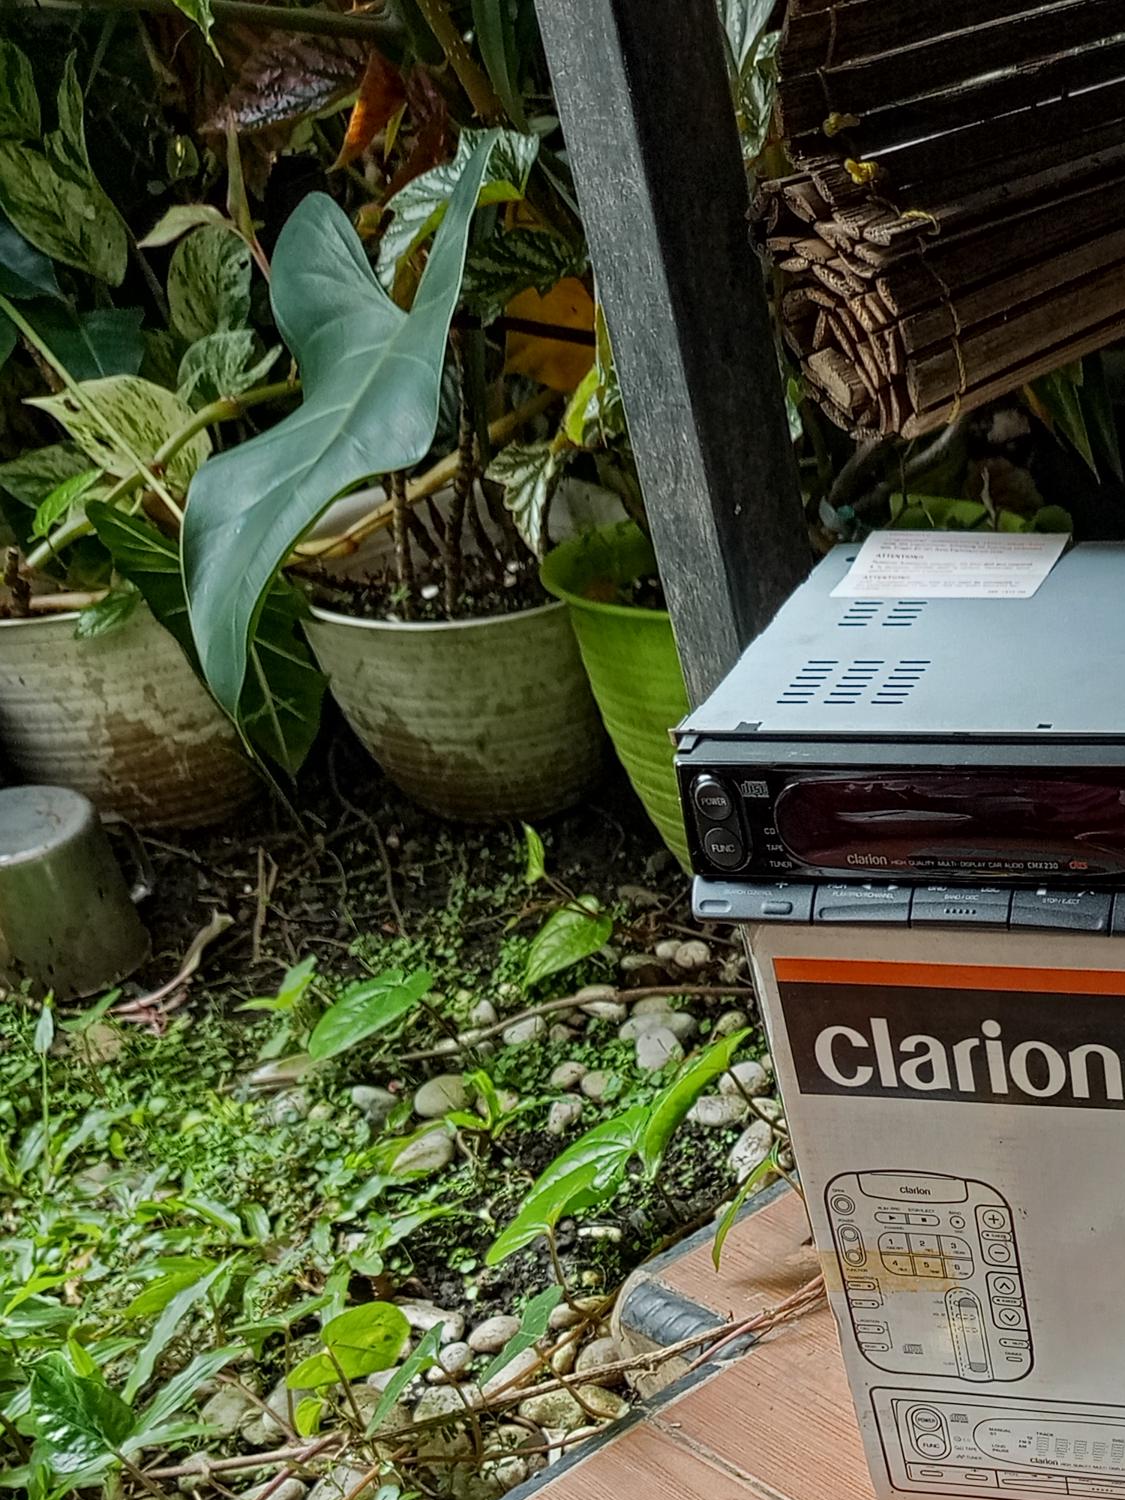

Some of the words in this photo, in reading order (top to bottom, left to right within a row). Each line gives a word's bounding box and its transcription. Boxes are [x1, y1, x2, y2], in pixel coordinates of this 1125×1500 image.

[701, 796, 728, 807] POWER
[711, 842, 735, 853] FUNC
[766, 843, 784, 852] TAPE
[769, 860, 793, 869] TUNER
[847, 853, 888, 866] clarion
[1027, 861, 1059, 870] CMX230
[814, 1017, 1125, 1101] clarion
[899, 1185, 932, 1196] clarion
